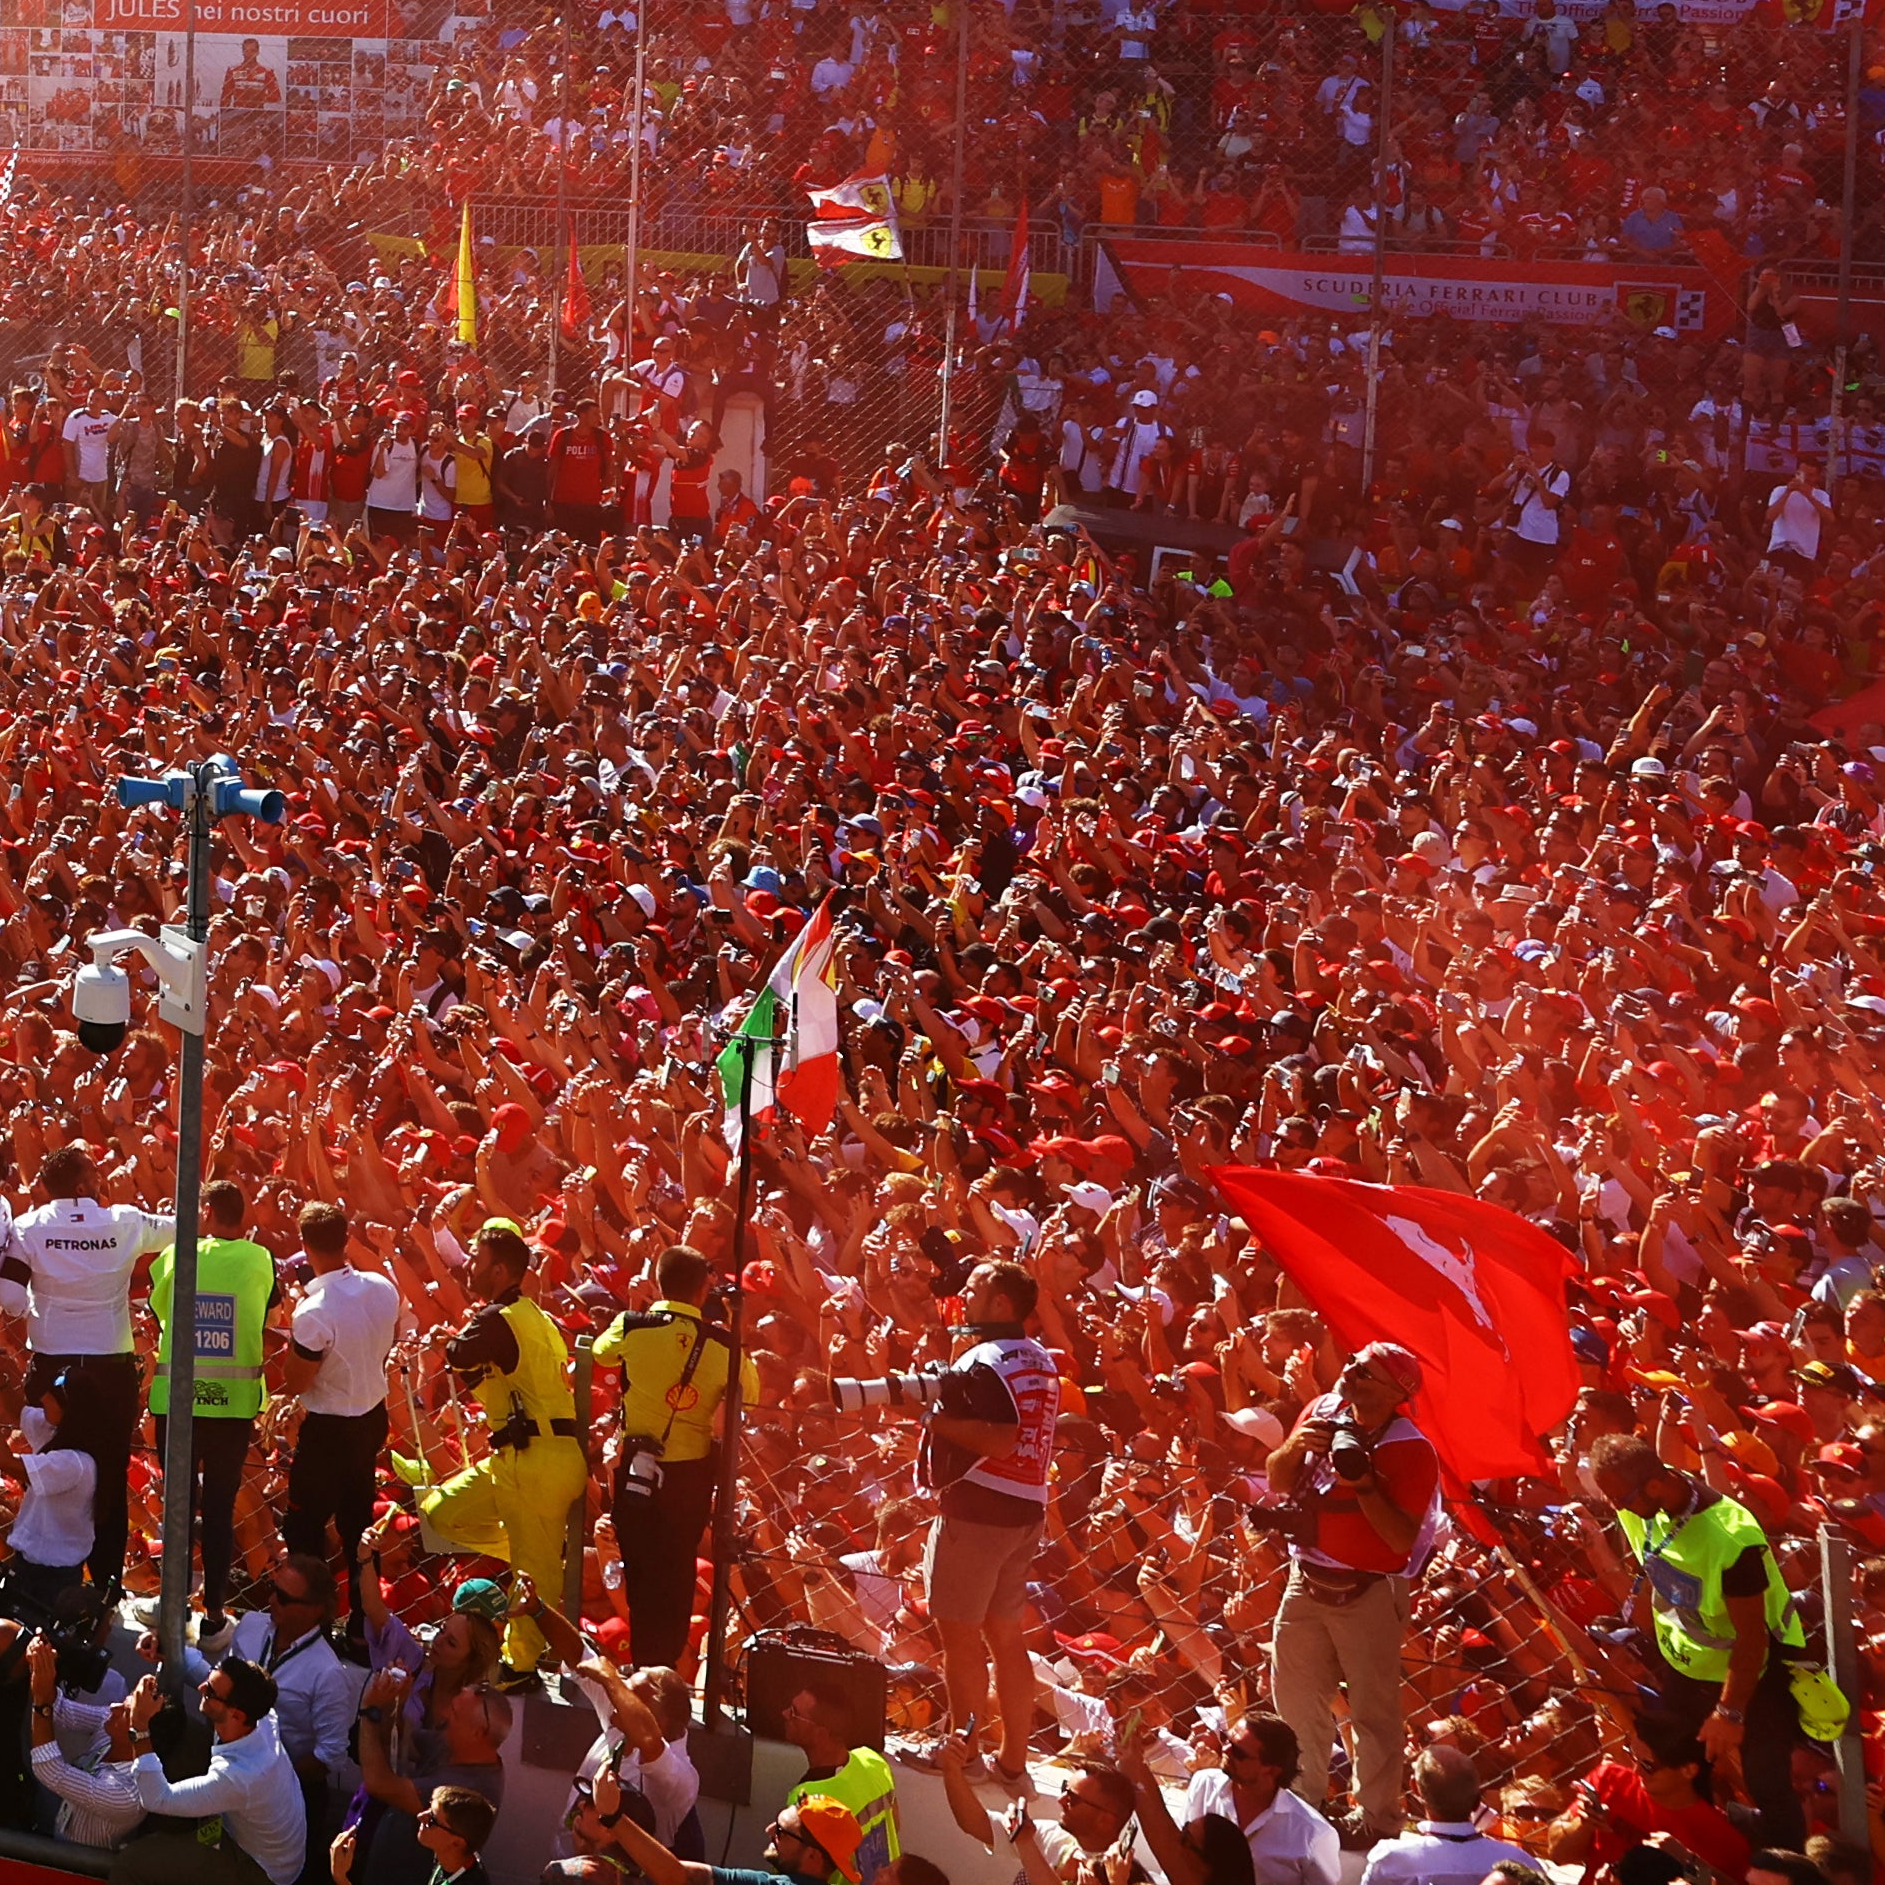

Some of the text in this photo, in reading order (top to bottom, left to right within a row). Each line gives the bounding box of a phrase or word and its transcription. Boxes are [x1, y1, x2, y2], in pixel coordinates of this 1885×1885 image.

[231, 2, 300, 24] nostri
[308, 3, 369, 25] cuori
[1431, 284, 1526, 304] FERRARI
[1537, 289, 1598, 306] CLUB
[44, 1237, 118, 1252] PETRONAS
